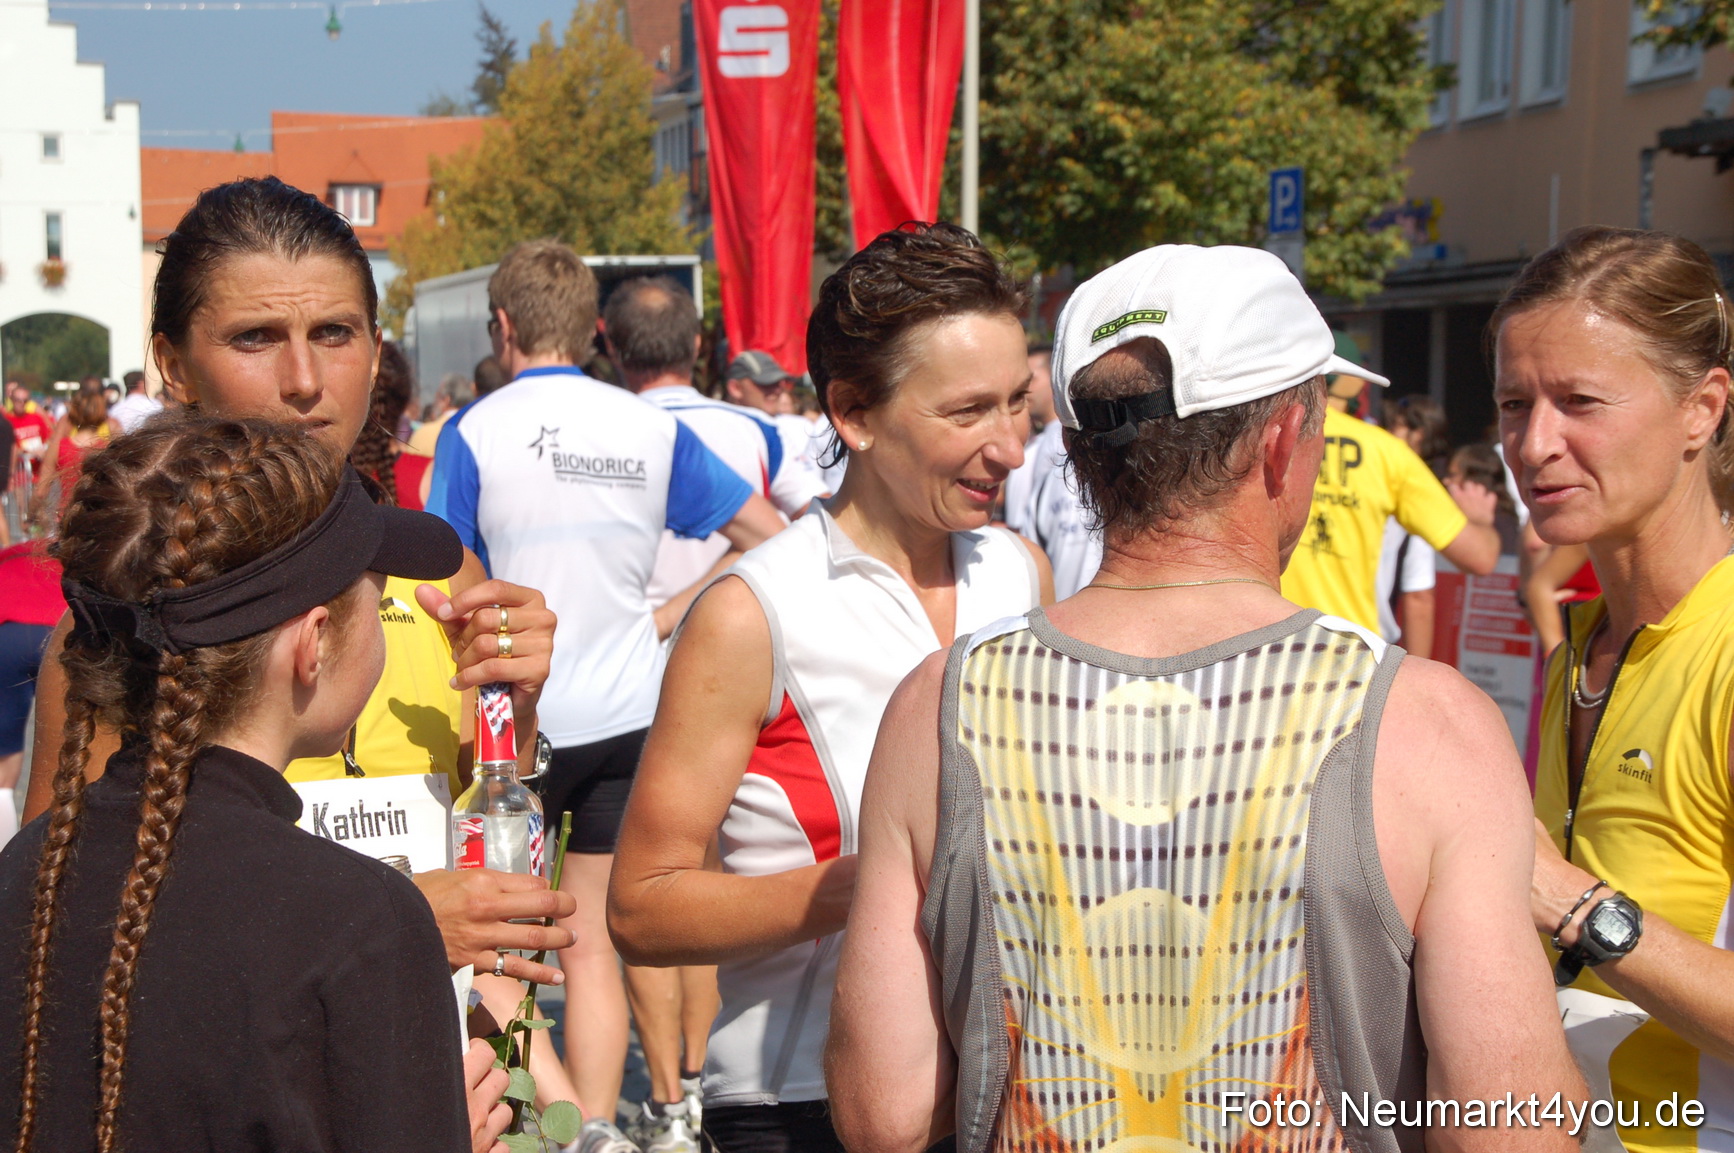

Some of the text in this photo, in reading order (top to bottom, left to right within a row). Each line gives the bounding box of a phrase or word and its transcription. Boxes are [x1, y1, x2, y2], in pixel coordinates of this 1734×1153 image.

[1275, 176, 1296, 227] P
[1094, 313, 1162, 337] EQUIPMENT
[552, 452, 646, 475] BIONORICA
[380, 612, 416, 624] skinfit
[1617, 763, 1652, 784] skinfit
[312, 799, 408, 841] Kathrin
